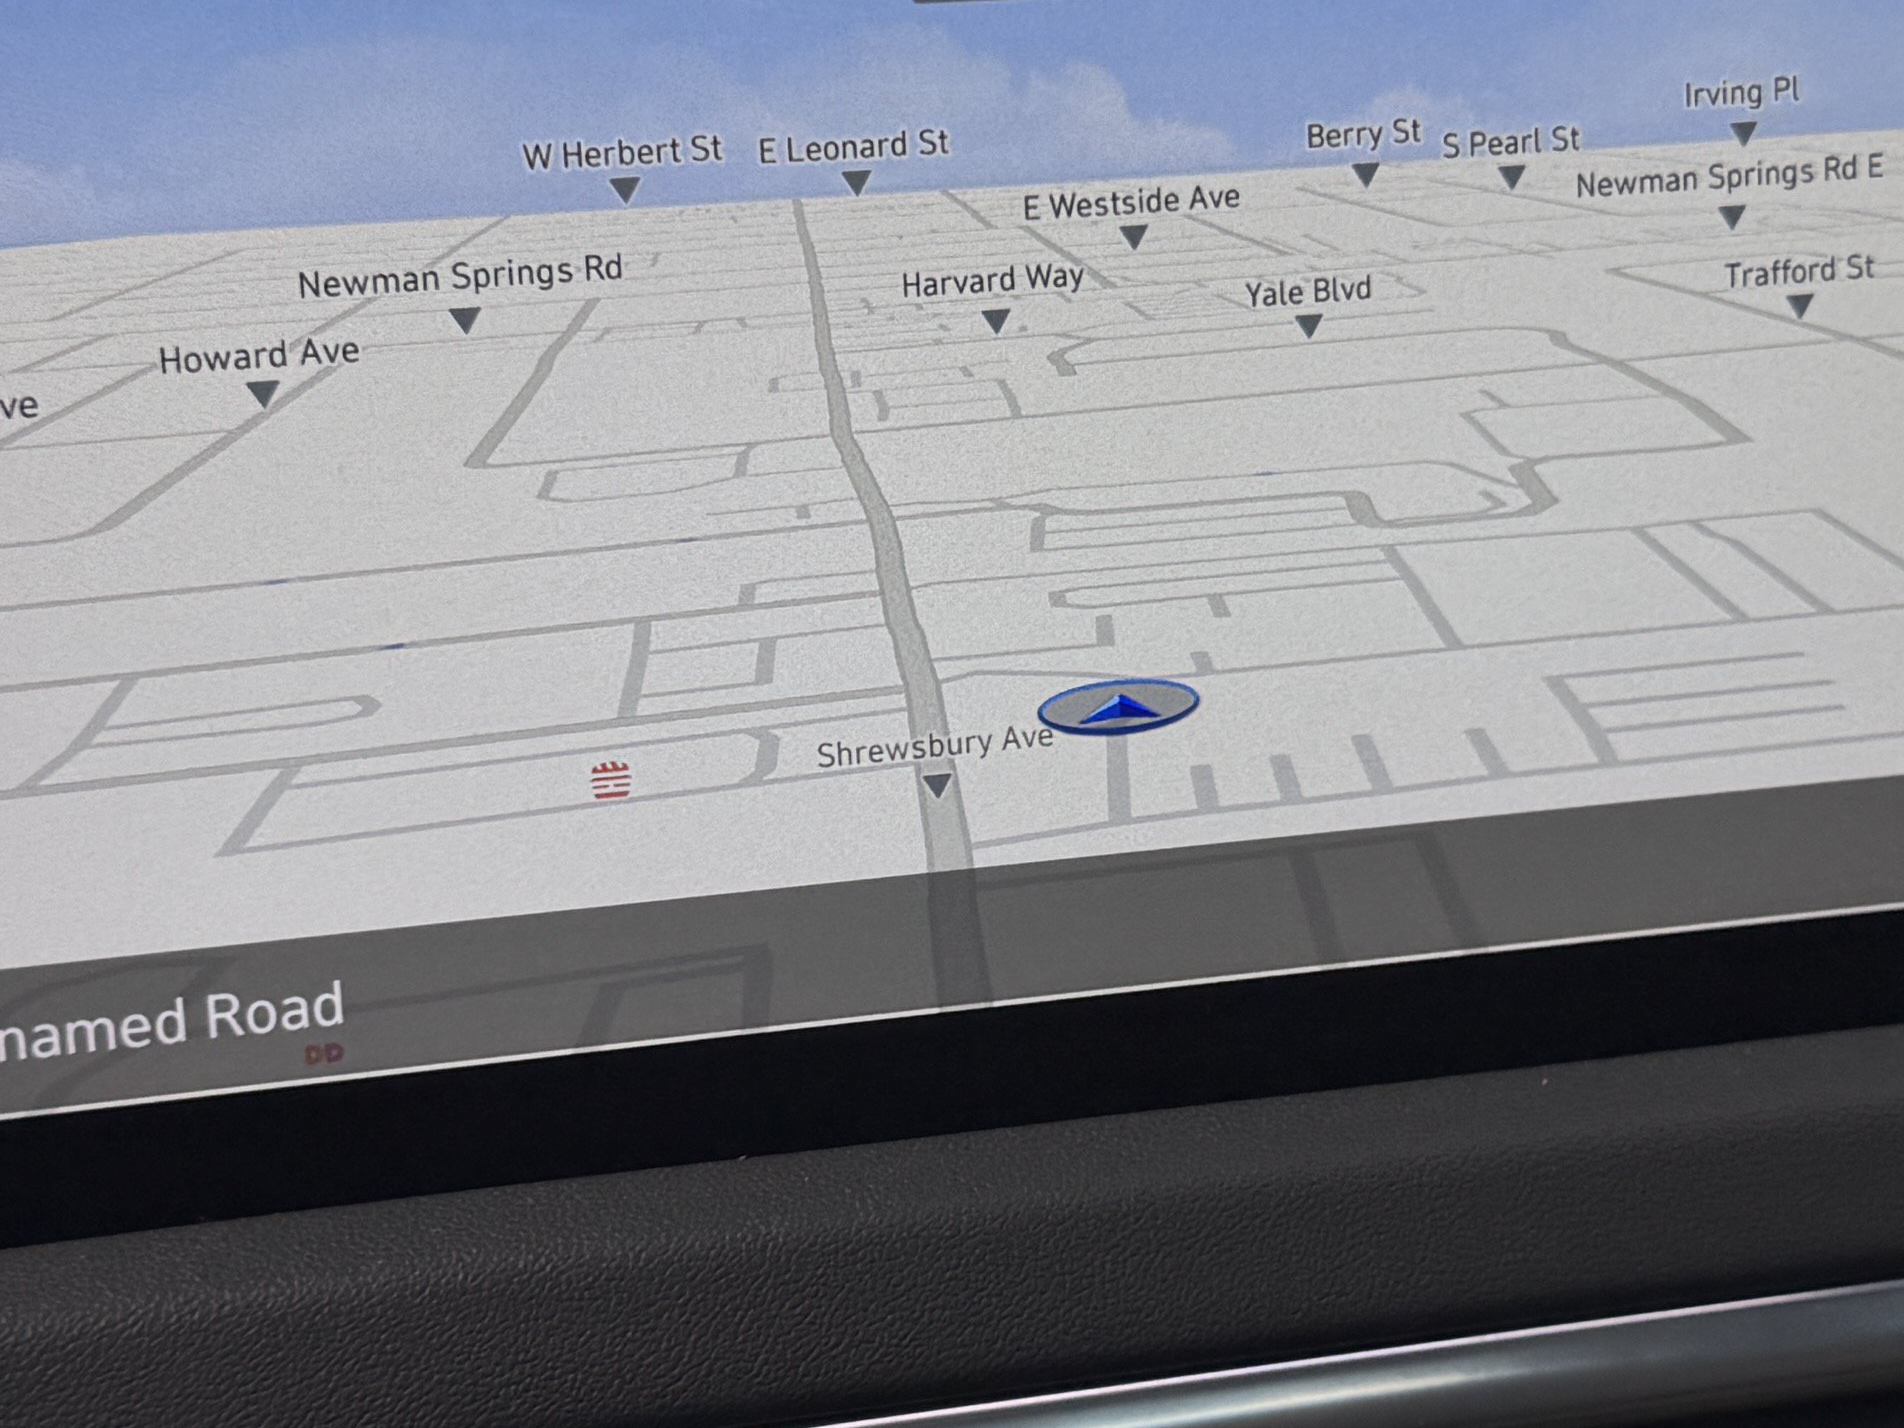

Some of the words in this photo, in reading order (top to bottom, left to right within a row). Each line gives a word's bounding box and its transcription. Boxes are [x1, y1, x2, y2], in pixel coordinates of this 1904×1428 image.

[1685, 79, 1763, 112] Irving
[1774, 74, 1801, 103] Pl
[523, 143, 553, 172] W
[562, 137, 682, 169] Herbert
[691, 134, 723, 164] St
[759, 138, 777, 163] E
[787, 130, 908, 164] Leonard
[918, 128, 950, 156] St
[1307, 122, 1383, 155] Berry
[1392, 118, 1421, 144] St
[1443, 134, 1461, 160] S
[1469, 128, 1541, 156] Pearl
[1552, 125, 1580, 152] St
[1577, 167, 1698, 200] Newman
[1709, 159, 1815, 196] Springs
[1824, 155, 1859, 184] Rd
[1868, 152, 1885, 179] E
[1025, 195, 1040, 221] E
[1048, 188, 1180, 220] Westside
[1189, 185, 1241, 211] Ave
[298, 264, 439, 300] Newman
[450, 257, 573, 299] Springs
[583, 252, 624, 283] Rd
[902, 268, 1015, 299] Harvard
[1024, 264, 1085, 295] Way
[1725, 256, 1837, 289] Trafford
[1846, 253, 1875, 283] St
[1246, 281, 1304, 309] Yale
[1313, 274, 1373, 304] Blvd
[159, 340, 287, 375] Howard
[299, 336, 359, 367] Ave
[818, 732, 992, 767] Shrewsbury
[1002, 725, 1053, 751] Ave
[208, 981, 345, 1040] Road
